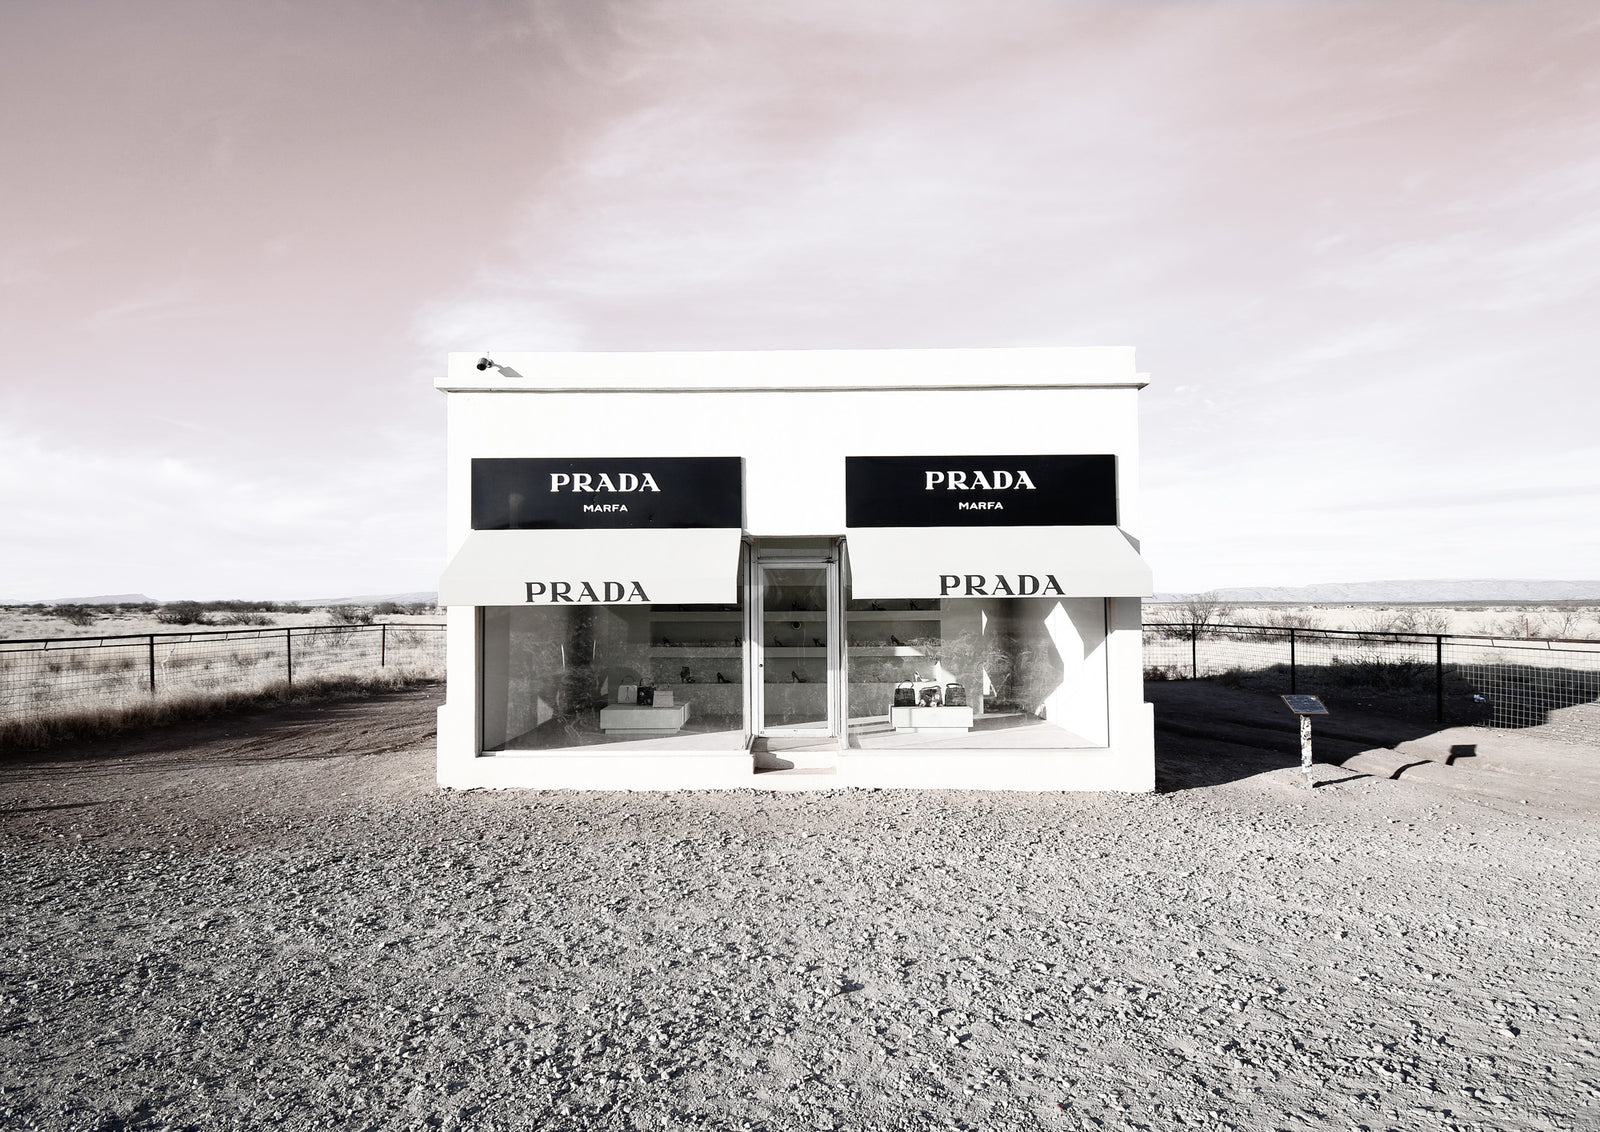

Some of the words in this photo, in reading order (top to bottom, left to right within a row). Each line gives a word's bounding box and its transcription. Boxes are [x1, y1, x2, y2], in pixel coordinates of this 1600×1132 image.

[549, 472, 662, 493] PRADA
[925, 470, 1037, 490] PRADA
[583, 503, 629, 513] MARFA
[958, 502, 1004, 510] MARFA
[524, 581, 651, 603] PRADA
[939, 574, 1066, 596] PRADA
